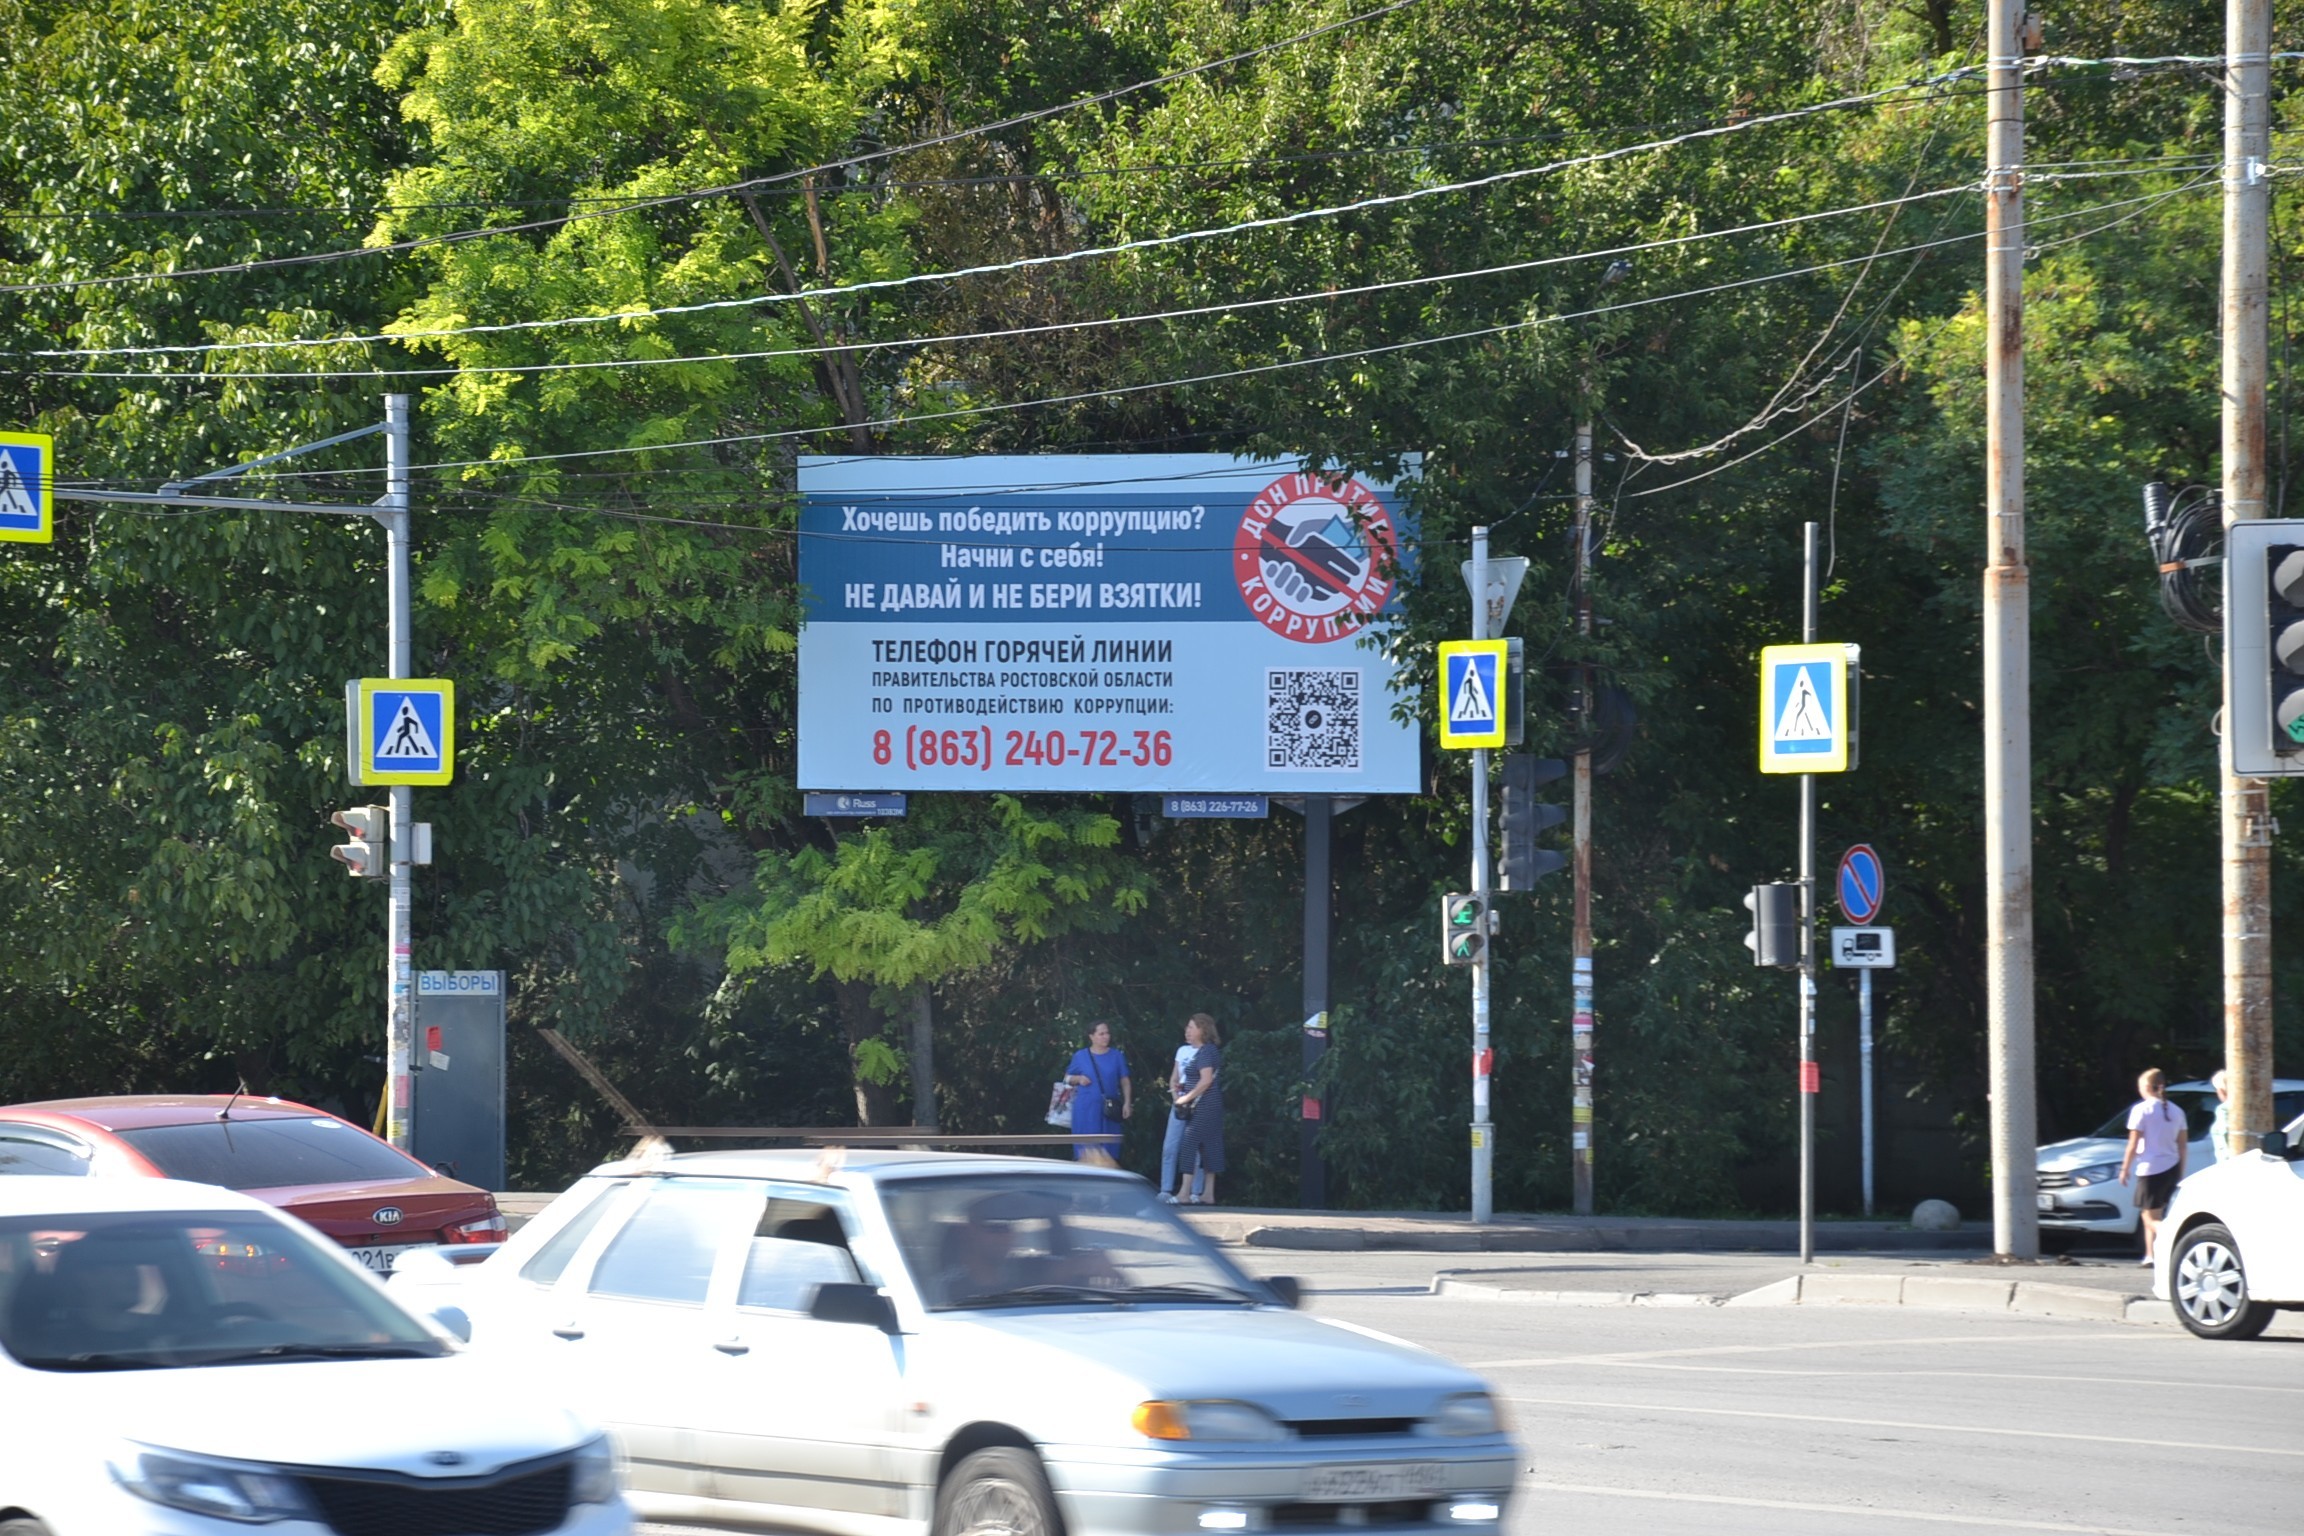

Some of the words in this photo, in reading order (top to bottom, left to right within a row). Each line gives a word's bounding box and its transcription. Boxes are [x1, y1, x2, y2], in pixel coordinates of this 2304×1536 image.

[841, 506, 934, 532] Хочешь
[938, 506, 1052, 535] победить
[1057, 505, 1205, 537] коррупцию?
[1242, 483, 1288, 540] ДОН
[941, 543, 1014, 568] Начни
[1020, 548, 1034, 568] с
[1040, 541, 1103, 568] себя!
[845, 583, 875, 609] НЕ
[880, 577, 961, 612] ДАВАЙ
[969, 583, 985, 609] И
[992, 583, 1023, 609] НЕ
[1030, 583, 1092, 608] БЕРИ
[1099, 582, 1201, 608] ВЗЯТКИ!
[872, 638, 977, 665] ТЕЛЕФОН
[985, 634, 1085, 663] ГОРЯЧЕЙ
[1091, 640, 1172, 663] ЛИНИИ
[872, 671, 996, 688] ПРАВИТЕЛЬСТВА
[1001, 668, 1099, 688] РОСТОВСКОЙ
[1104, 671, 1173, 687] ОБЛАСТИ
[872, 697, 893, 713] ПО
[903, 694, 1064, 716] ПРОТИВОДЕЙСТВИЮ
[1074, 698, 1174, 716] КОРРУПЦИИ:
[873, 729, 892, 765] 8
[906, 724, 992, 771] (863)
[1005, 730, 1172, 767] 240-72-36
[852, 798, 877, 809] Russ
[1171, 801, 1179, 812] 8
[1180, 800, 1207, 813] (863)
[1208, 801, 1258, 813] 226-77-26
[421, 975, 496, 991] ВЫБОРЫ
[379, 1211, 400, 1223] KIA
